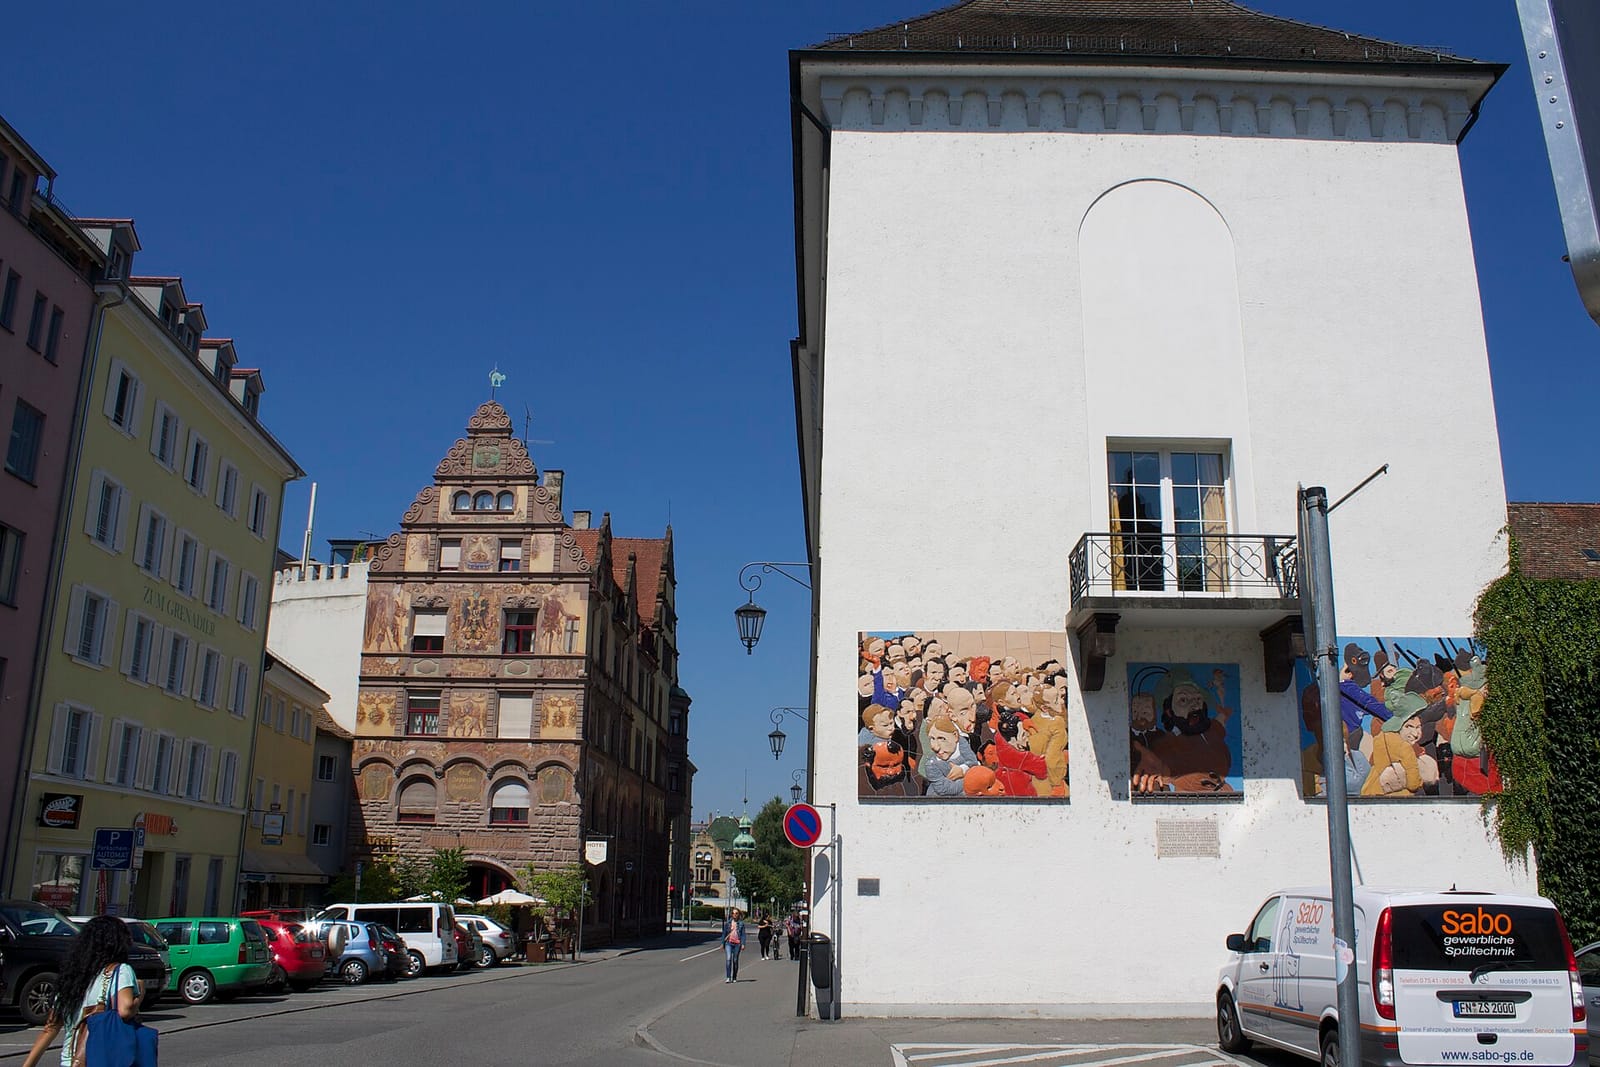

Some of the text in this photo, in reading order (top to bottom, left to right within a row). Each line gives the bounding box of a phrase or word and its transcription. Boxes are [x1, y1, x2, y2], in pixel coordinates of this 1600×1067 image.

[144, 586, 217, 638] ZUM GRENADIER
[110, 831, 121, 846] P
[1295, 925, 1320, 935] gewerbliche
[1293, 935, 1318, 946] Spültechnik
[1443, 936, 1515, 946] gewerbliche
[1444, 946, 1516, 957] Spültechnik
[1459, 1002, 1514, 1014] FN ZS 2000
[1441, 1049, 1534, 1062] www.sabo-gs.de
